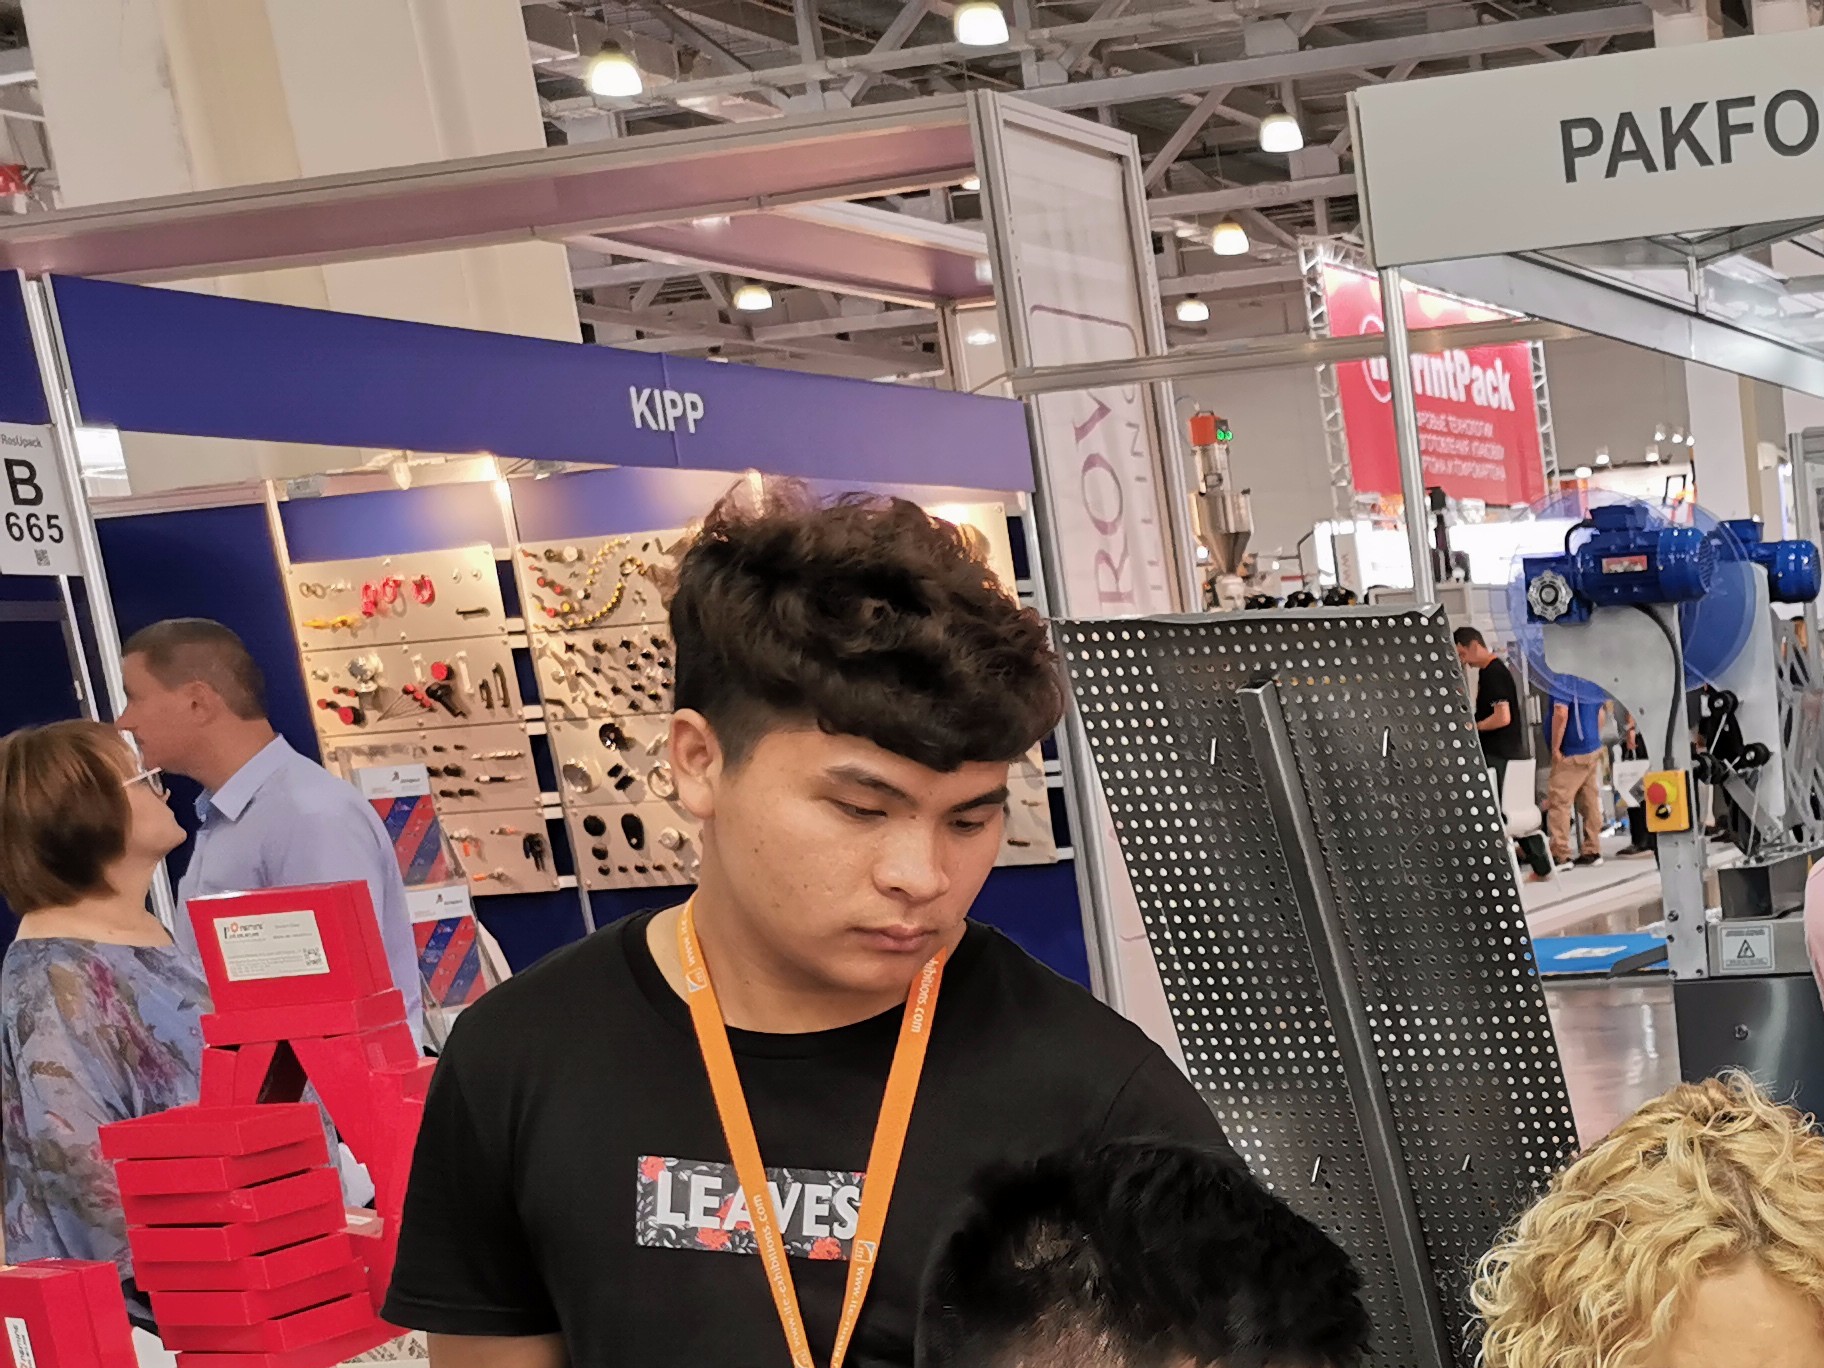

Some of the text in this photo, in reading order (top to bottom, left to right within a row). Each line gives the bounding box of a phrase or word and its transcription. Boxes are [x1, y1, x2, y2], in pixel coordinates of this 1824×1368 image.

[629, 386, 704, 434] KIPP
[4, 457, 44, 506] B
[5, 511, 65, 544] 665
[656, 1170, 862, 1240] LEAVES
